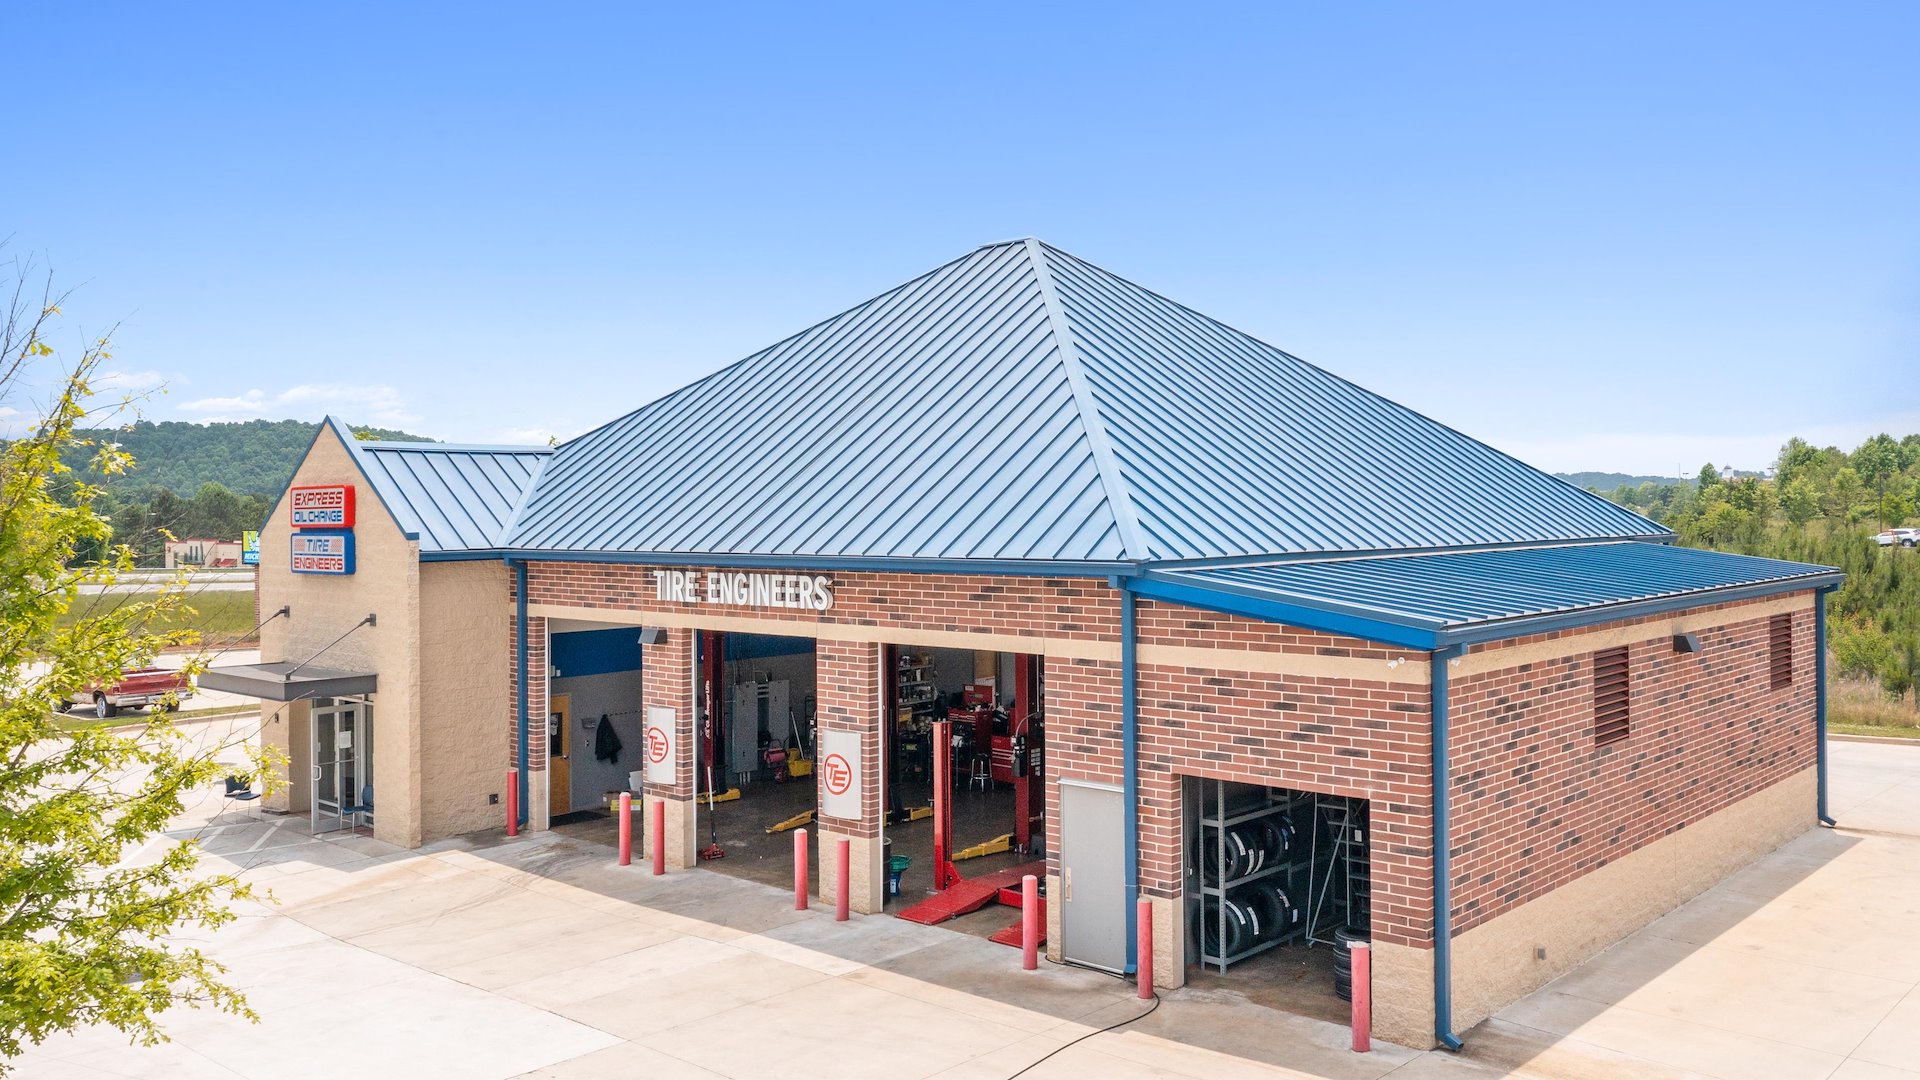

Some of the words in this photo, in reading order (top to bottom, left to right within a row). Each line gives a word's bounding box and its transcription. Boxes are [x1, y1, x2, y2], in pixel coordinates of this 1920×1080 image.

[294, 491, 343, 506] EXPRESS
[294, 511, 307, 522] OIL
[308, 510, 342, 522] CHANGE
[306, 539, 330, 552] TIRE
[294, 557, 343, 570] ENGINEERS
[653, 570, 702, 603] TIRE
[707, 572, 834, 611] ENGINEERS
[649, 735, 665, 757] TE
[827, 762, 848, 788] TE
